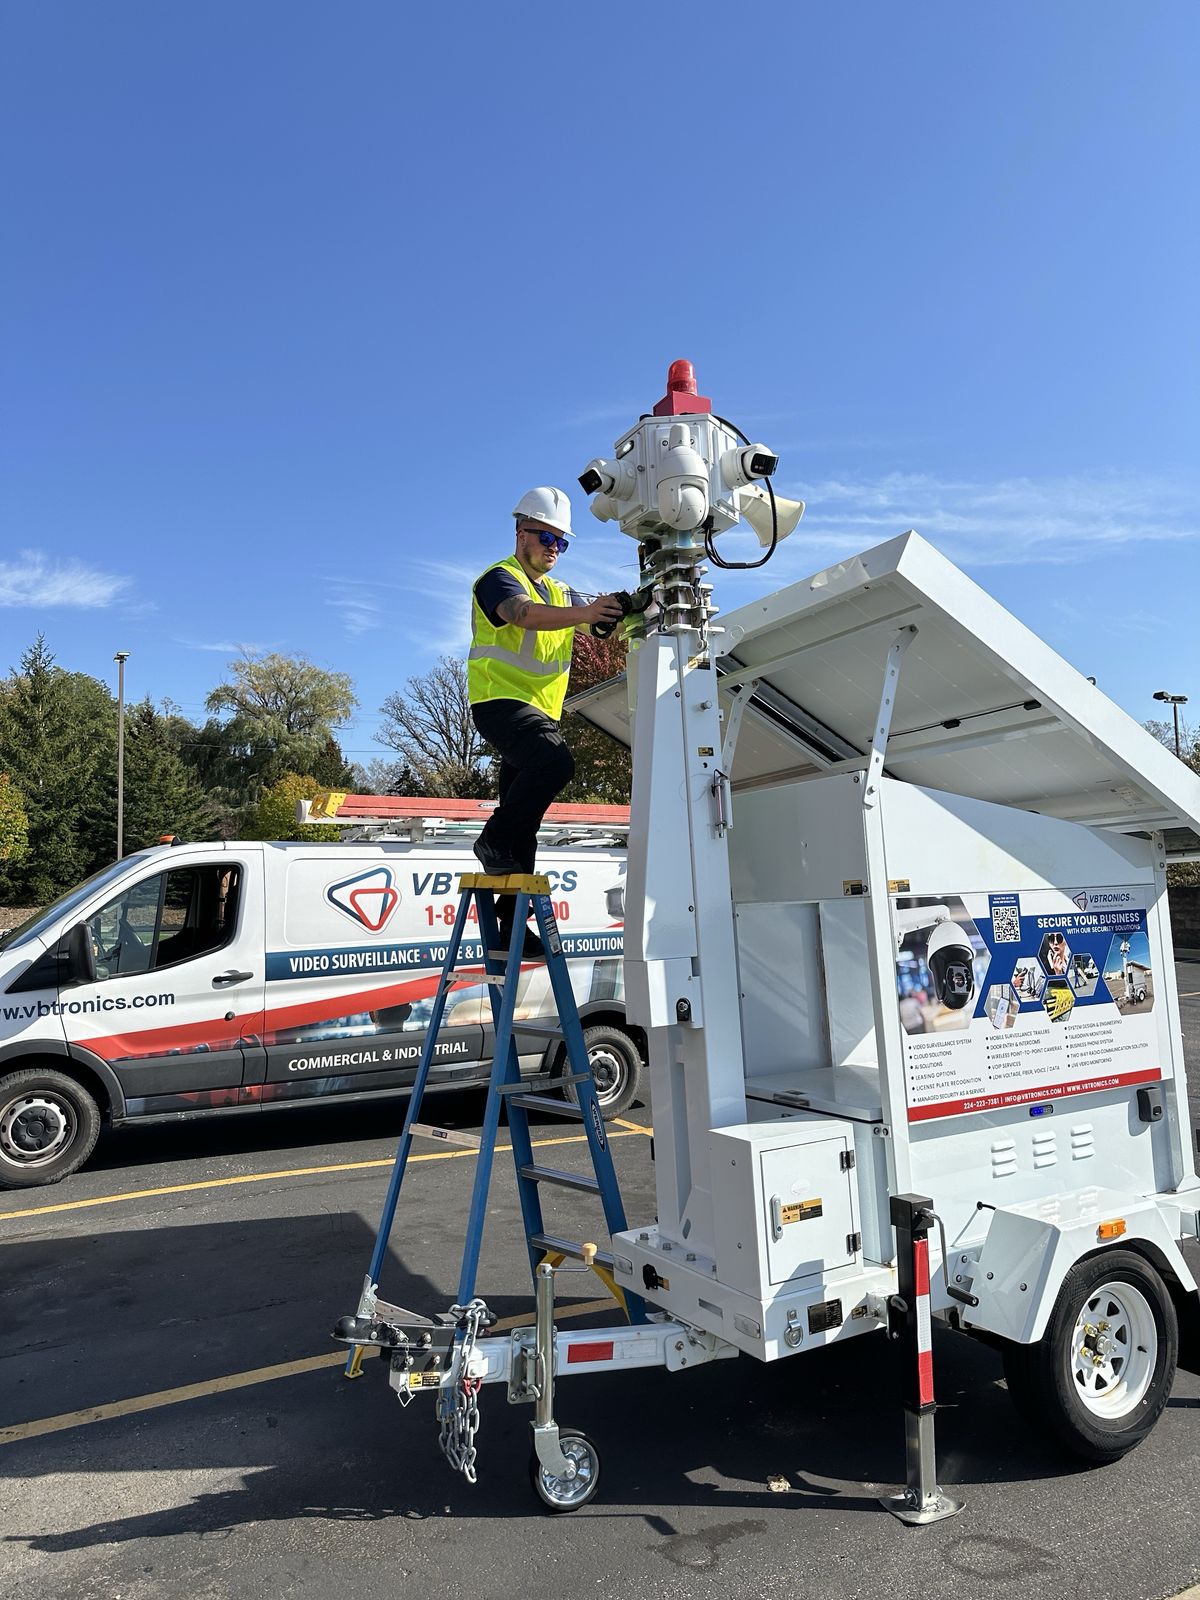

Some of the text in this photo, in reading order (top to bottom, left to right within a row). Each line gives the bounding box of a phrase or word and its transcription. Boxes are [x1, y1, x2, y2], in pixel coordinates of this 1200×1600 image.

[1090, 893, 1130, 903] VBTRONICS
[1038, 913, 1139, 928] SECURE YOUR BUSINESS
[289, 957, 329, 972] VIDEO
[332, 949, 420, 969] SURVEILLANCE
[430, 946, 462, 961] VOE
[465, 945, 474, 958] &
[0, 993, 174, 1020] w.vbtronics.com
[1005, 1031, 1032, 1039] SURVEILLANCE
[927, 1040, 955, 1048] SURVEILLANCE
[929, 1050, 952, 1058] SOLUTIONS
[1011, 1048, 1043, 1057] POINT-TO-POINT
[1101, 1045, 1131, 1054] COMMUNICATION
[288, 1042, 468, 1071] COMMERCIAL & INDTRIAL
[936, 1070, 956, 1078] OPTIONS
[951, 1077, 981, 1085] RECOGNITION
[964, 1098, 999, 1109] 224-223-7381
[1005, 1089, 1062, 1102] INFO@VBTRONICS.COM
[1067, 1078, 1119, 1092] WWW.VBTRONICS.COM
